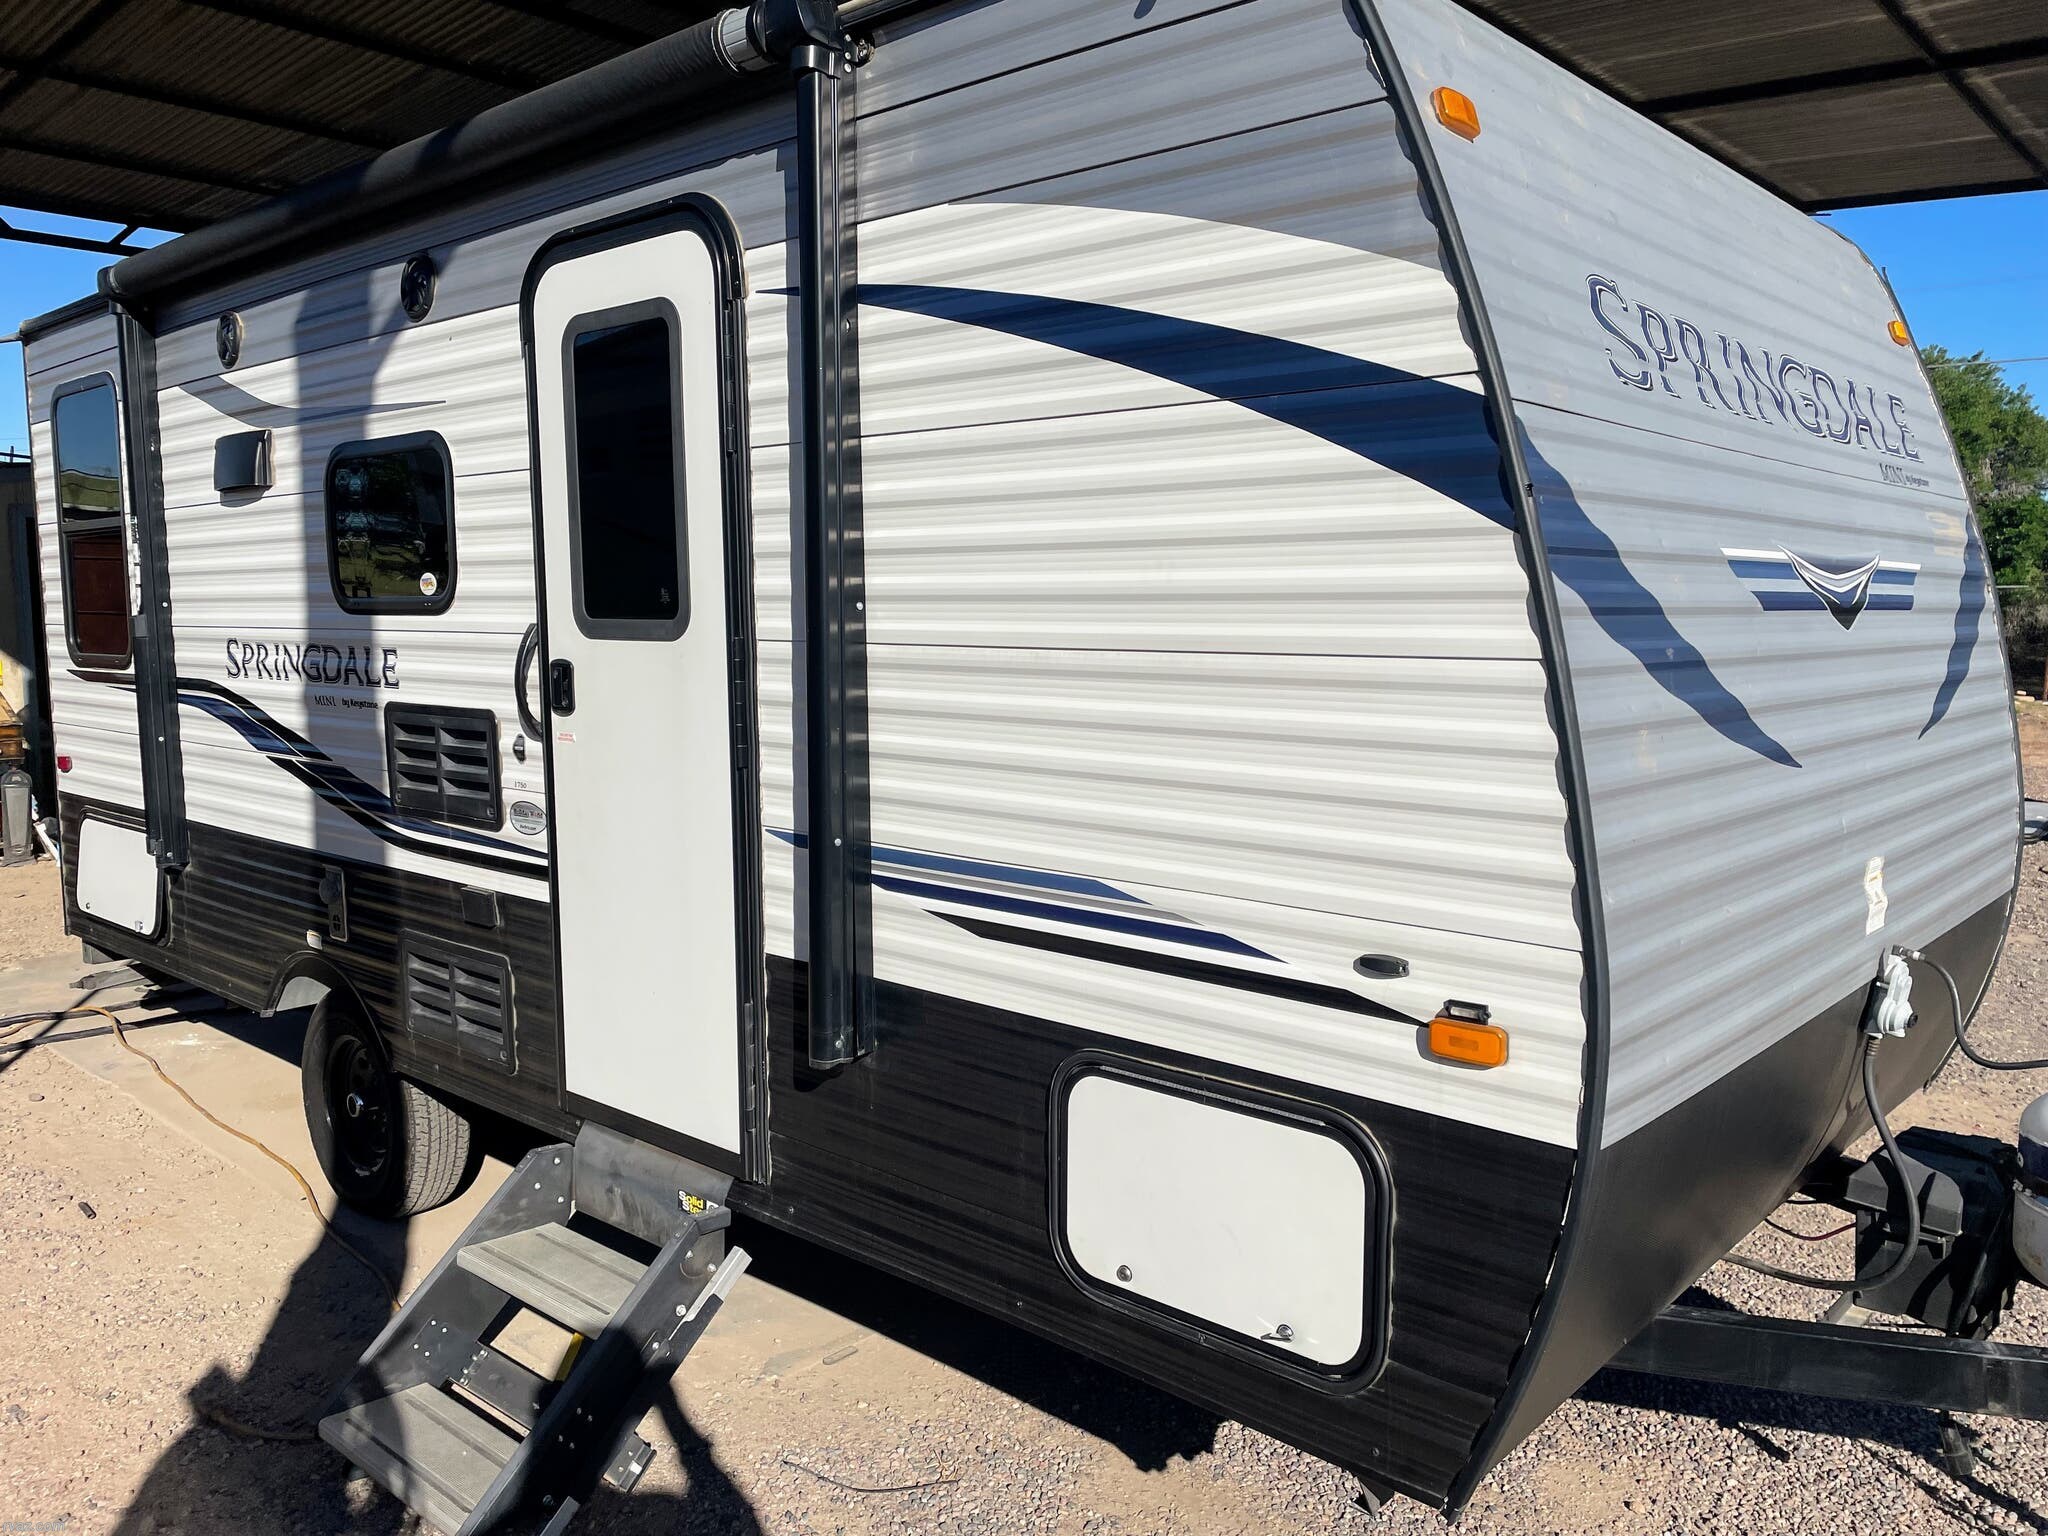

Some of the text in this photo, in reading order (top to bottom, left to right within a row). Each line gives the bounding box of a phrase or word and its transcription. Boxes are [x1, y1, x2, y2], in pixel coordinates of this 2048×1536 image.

[1585, 273, 1924, 463] SPRINGDALE
[226, 637, 400, 689] SPRINGDALE
[314, 694, 378, 709] MINI by Keystone
[678, 1190, 704, 1210] Solid
